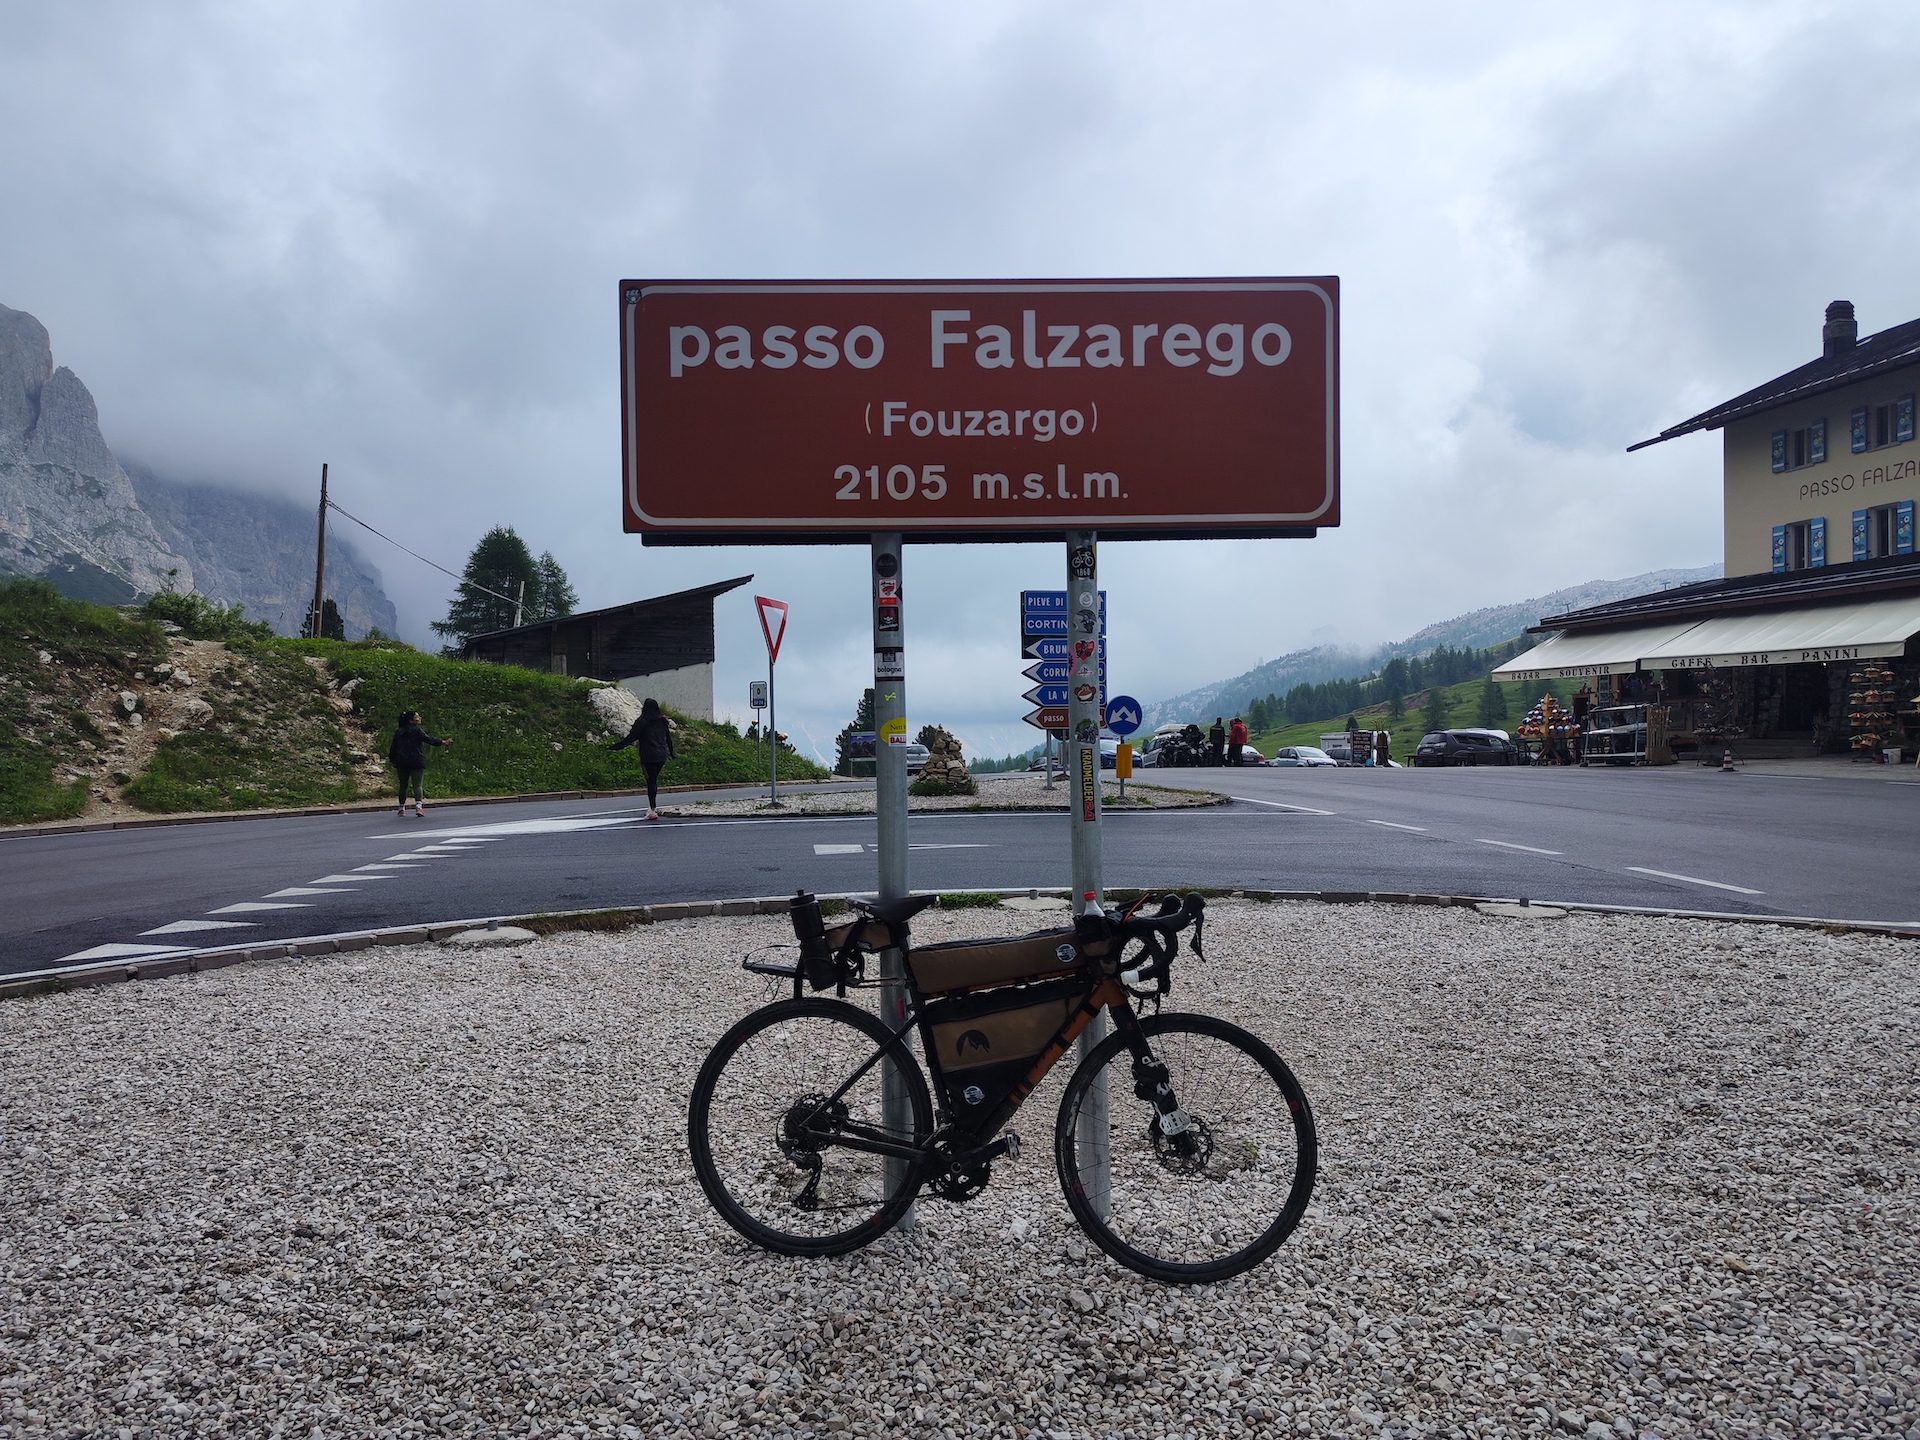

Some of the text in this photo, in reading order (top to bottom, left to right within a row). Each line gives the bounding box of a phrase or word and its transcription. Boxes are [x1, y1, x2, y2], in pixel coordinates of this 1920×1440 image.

[669, 309, 1292, 378] passo Falzarego
[865, 401, 1098, 442] (Fouzargo)
[834, 464, 1129, 501] 2105 m.s.l.m.
[1799, 474, 1855, 501] PASSO
[1028, 597, 1064, 607] PIEVE DI
[1741, 654, 1769, 665] BAR
[1801, 648, 1859, 661] PANINI
[1511, 671, 1540, 680] BAZAR
[1559, 666, 1610, 678] SOUVENIR
[1048, 690, 1058, 700] LA
[1043, 715, 1065, 723] passo
